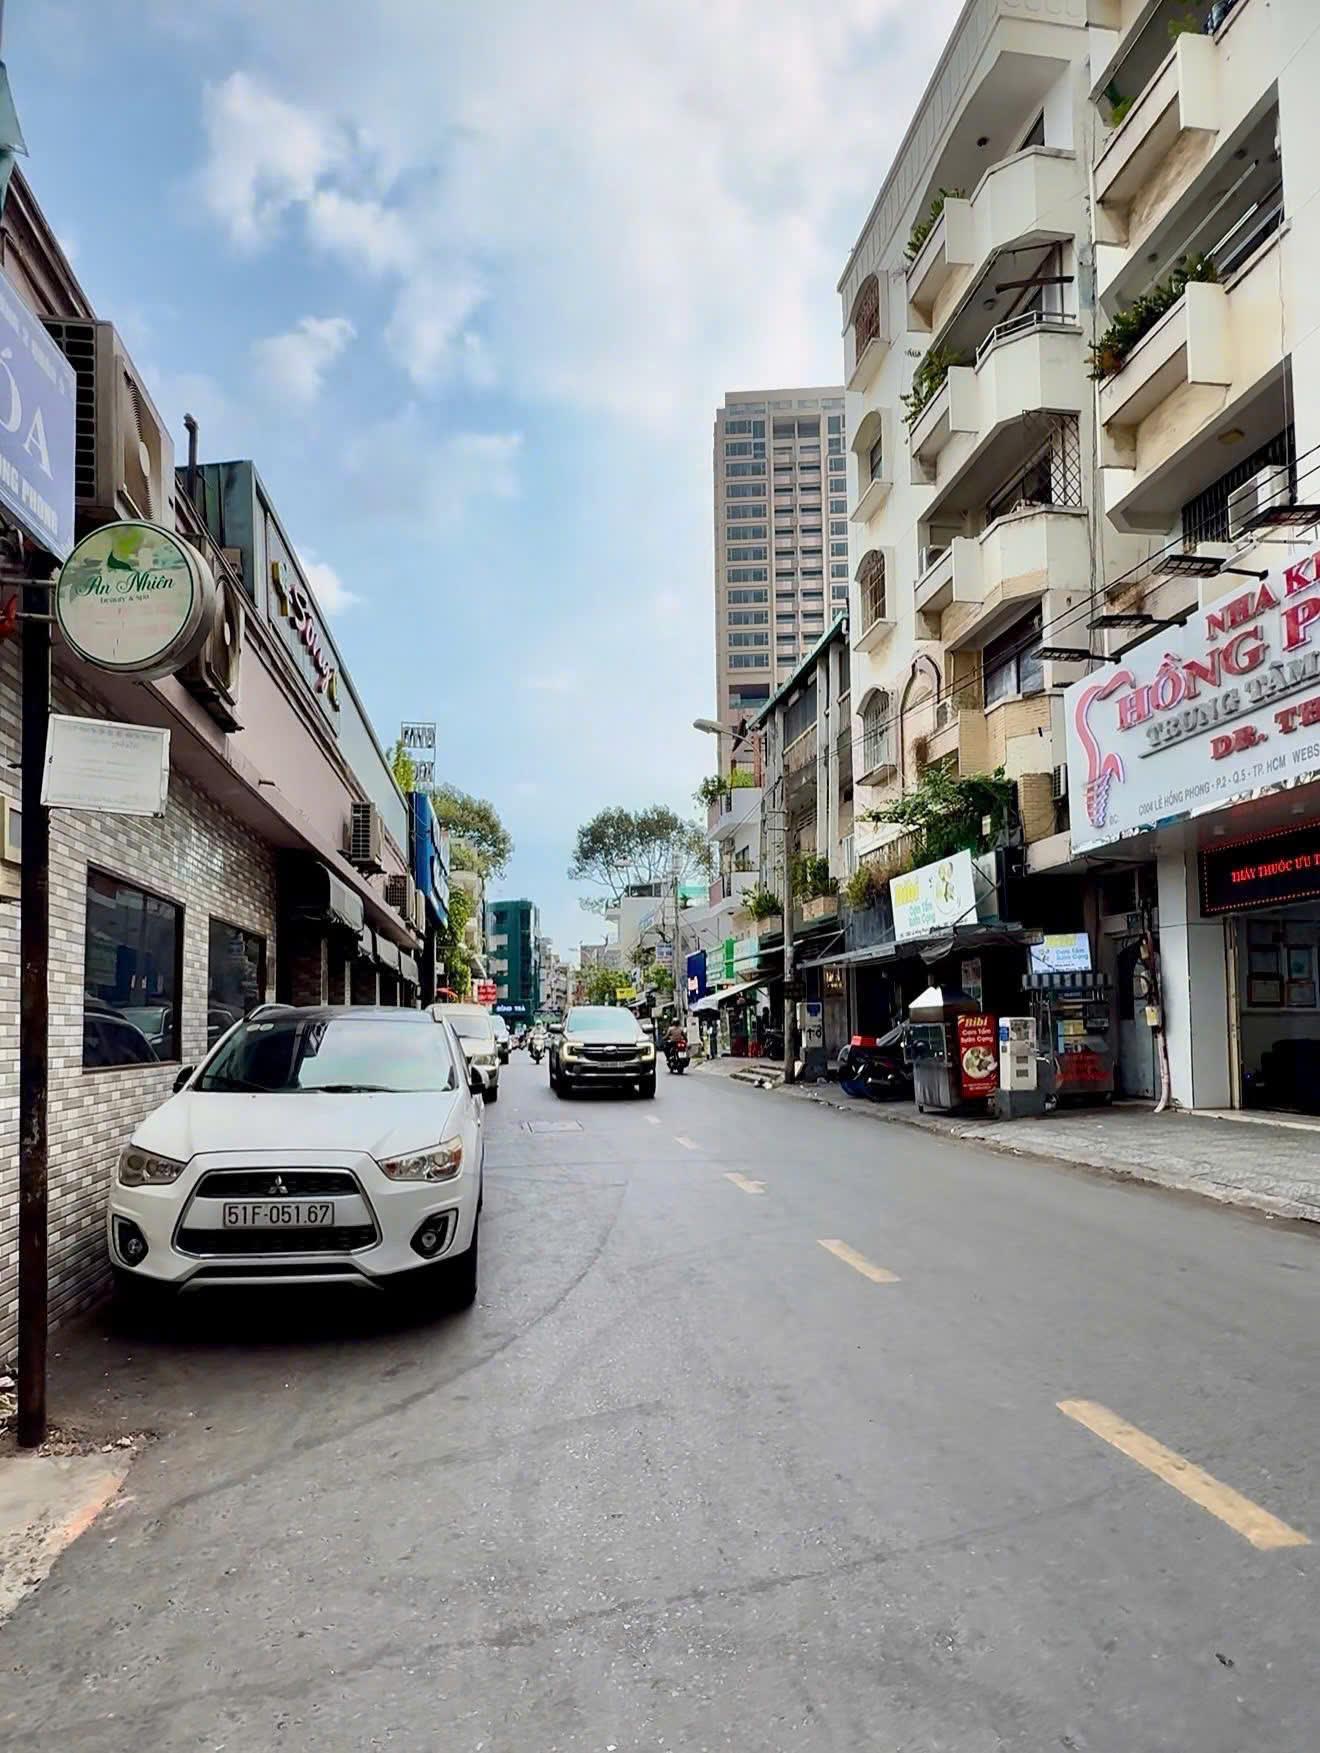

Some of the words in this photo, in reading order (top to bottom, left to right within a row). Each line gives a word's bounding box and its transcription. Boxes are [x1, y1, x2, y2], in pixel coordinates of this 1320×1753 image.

[76, 574, 111, 596] An
[115, 570, 175, 594] Nhiên
[1206, 582, 1280, 641] NHA
[1115, 624, 1270, 732] HỒNG
[1146, 687, 1241, 748] TRUNG
[1210, 724, 1269, 761] DR.
[1184, 781, 1210, 801] PHONG
[1266, 754, 1286, 774] HCM
[228, 1205, 330, 1225] 51F-051.67
